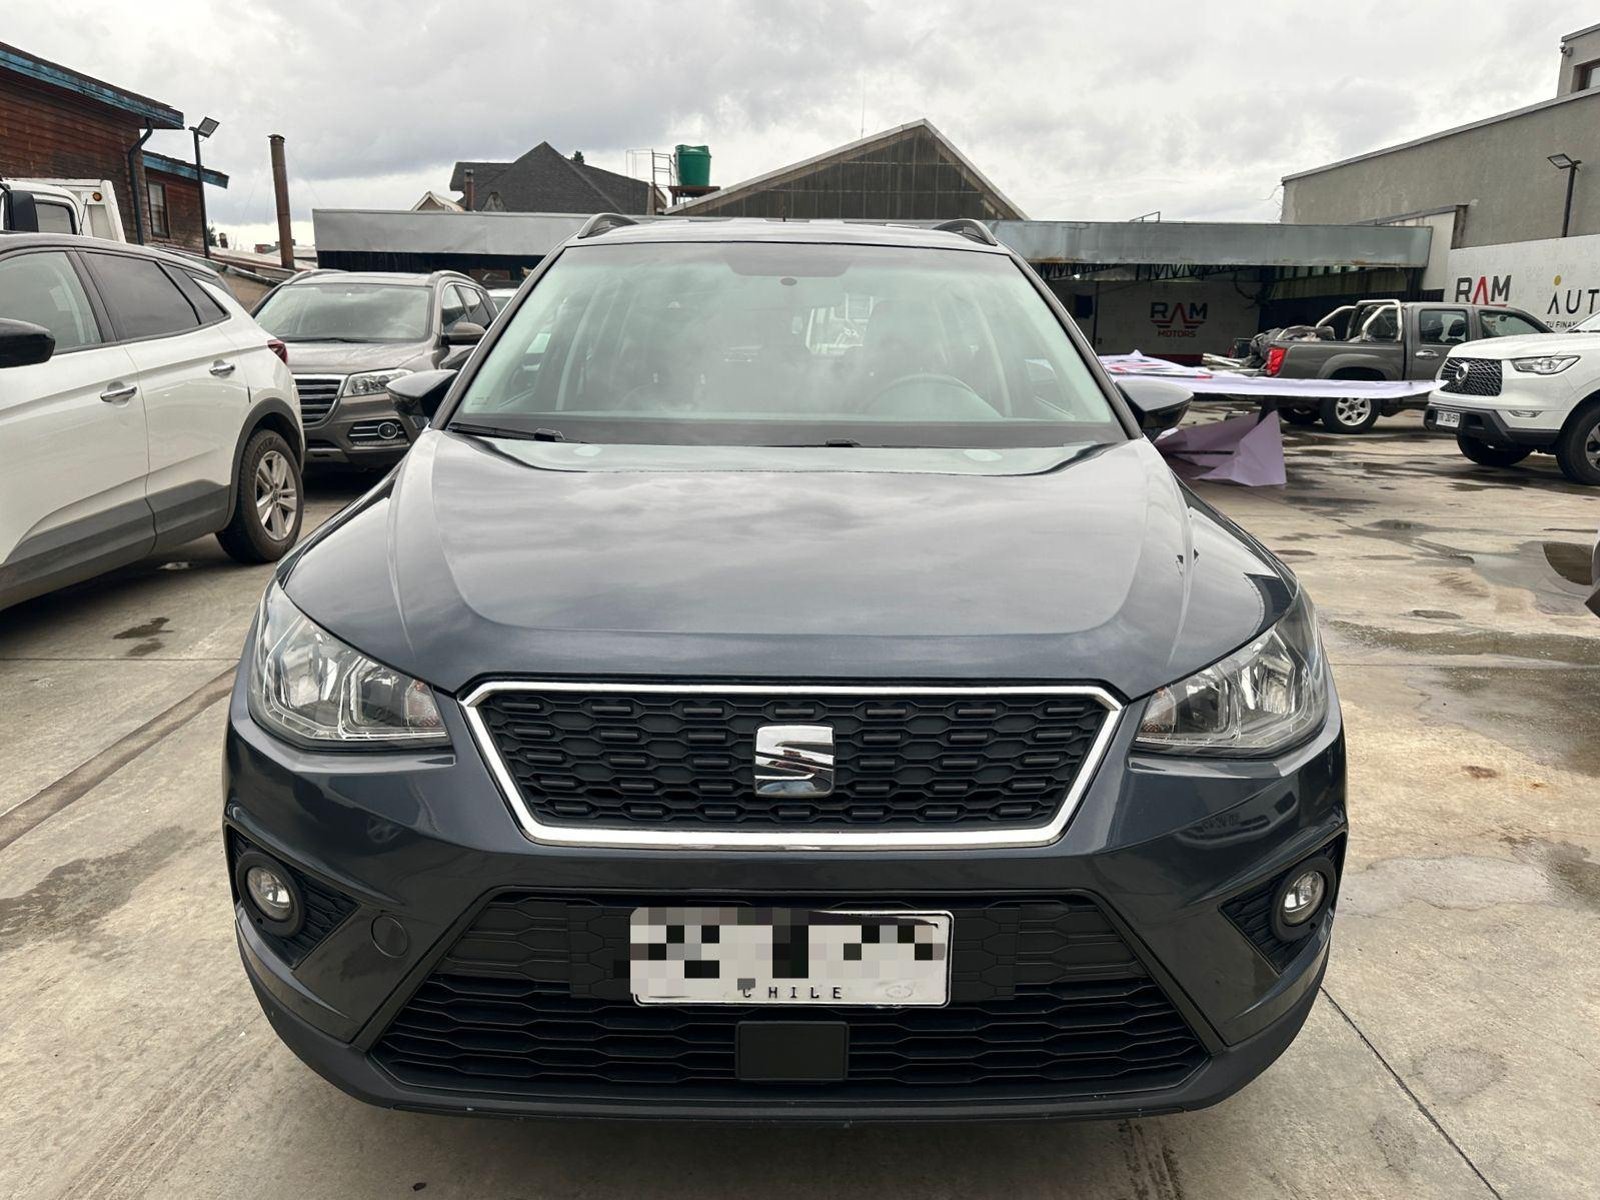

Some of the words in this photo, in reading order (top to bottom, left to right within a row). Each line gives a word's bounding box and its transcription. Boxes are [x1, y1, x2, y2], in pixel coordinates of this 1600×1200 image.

[1455, 275, 1511, 305] RAM
[1150, 302, 1208, 323] RAM
[1158, 330, 1196, 338] MOTORS
[742, 986, 842, 999] CHILE
